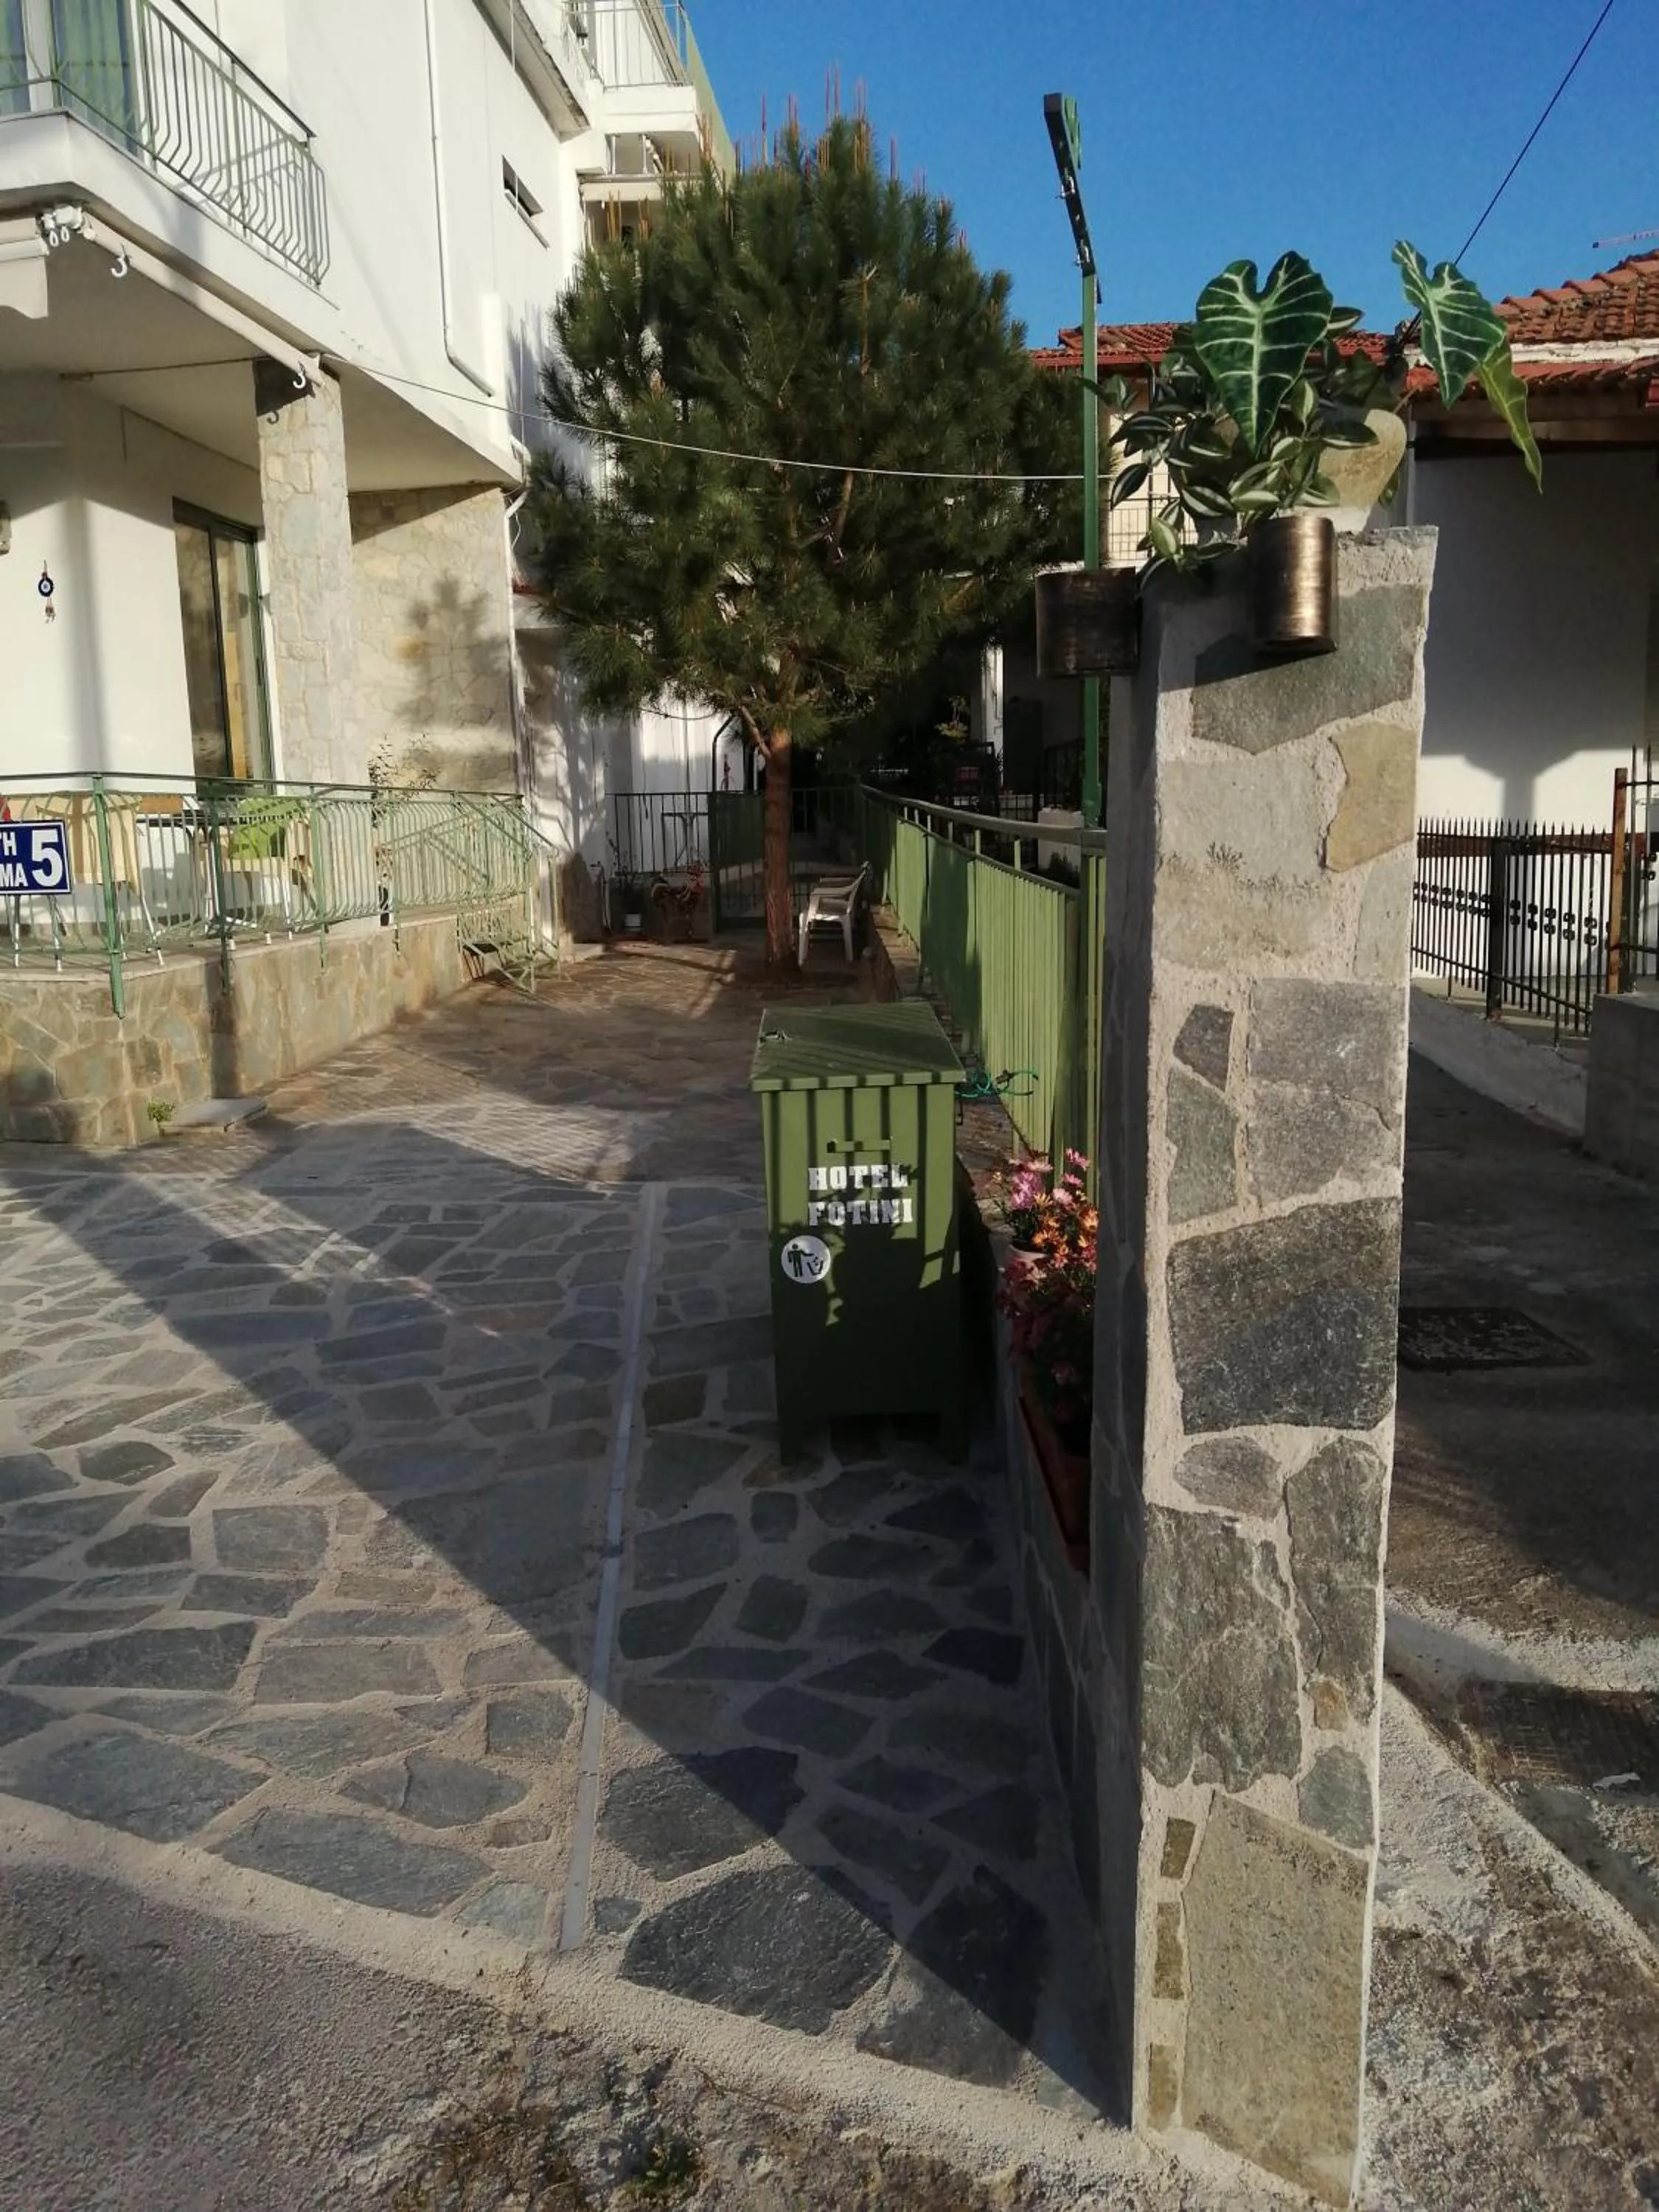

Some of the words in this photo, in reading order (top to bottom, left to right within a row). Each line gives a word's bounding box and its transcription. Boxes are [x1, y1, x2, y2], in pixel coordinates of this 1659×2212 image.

[32, 829, 63, 887] 5
[808, 1164, 908, 1190] HOTEL
[808, 1197, 913, 1225] FOTINI
